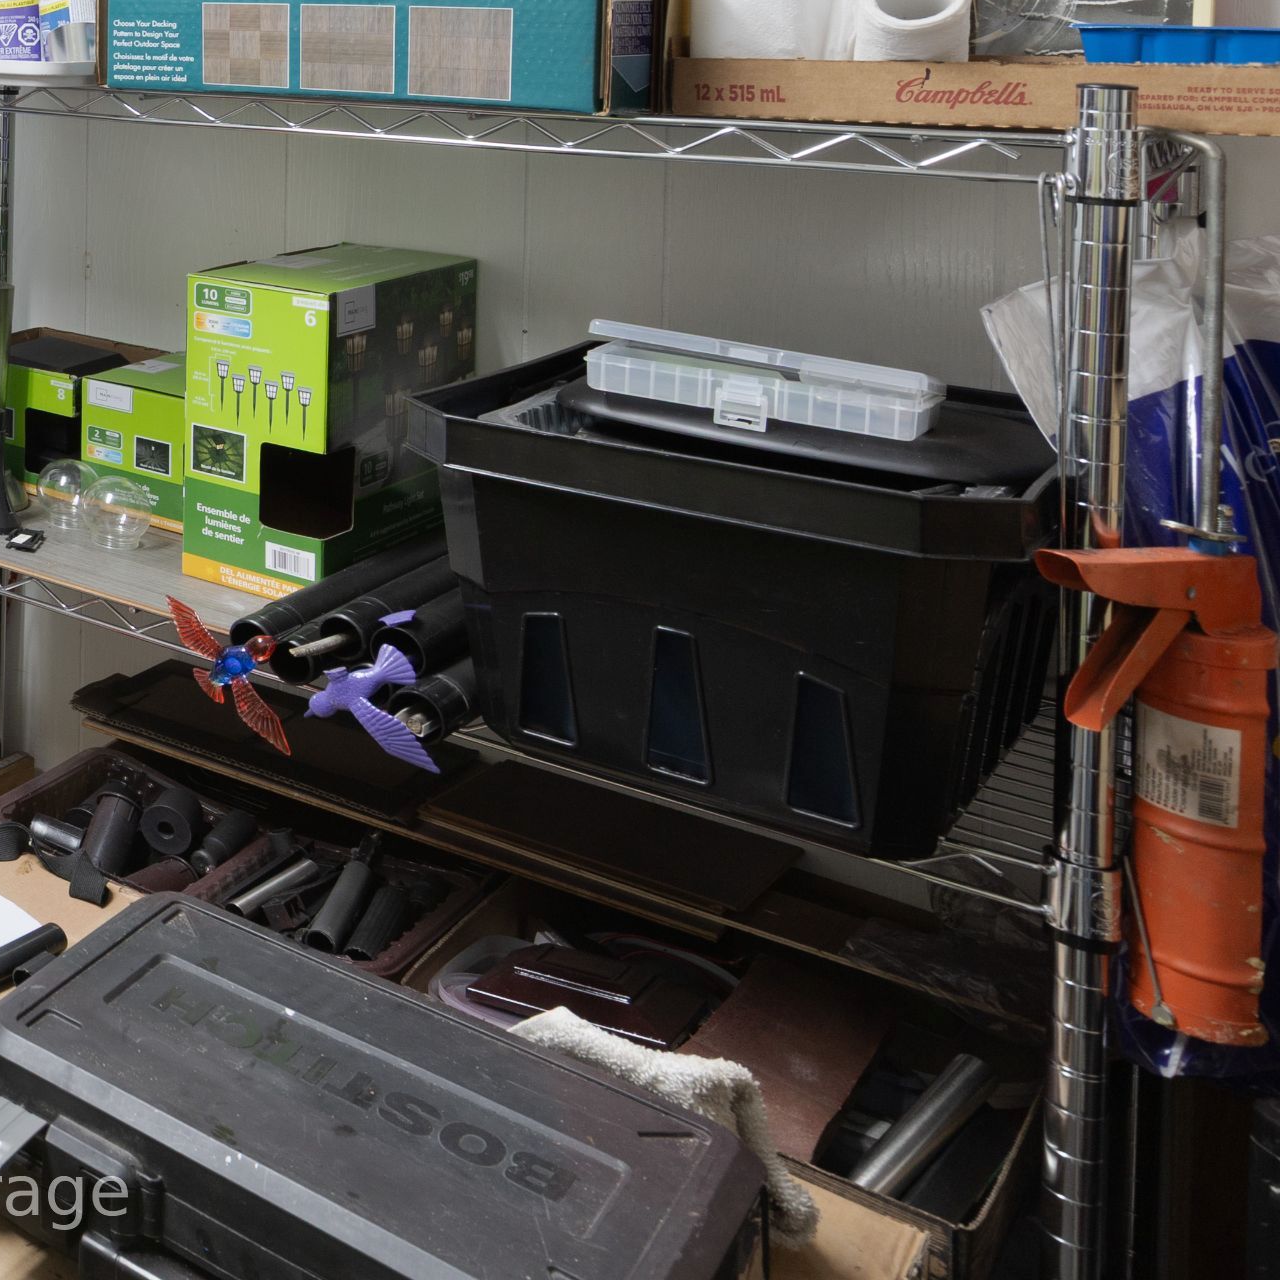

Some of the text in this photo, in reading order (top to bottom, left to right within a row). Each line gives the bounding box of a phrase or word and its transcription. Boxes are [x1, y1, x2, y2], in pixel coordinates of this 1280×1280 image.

[113, 19, 177, 29] Choose Your Decking
[142, 30, 163, 39] Design
[133, 40, 159, 48] Outdoor
[161, 41, 180, 49] Space
[113, 52, 145, 60] Choisissez
[152, 53, 168, 61] motif
[113, 62, 141, 72] platelage
[144, 73, 160, 82] plein
[694, 83, 786, 103] 12 x 515 mL
[895, 77, 1029, 110] Campbell's
[1187, 86, 1218, 94] READY
[1236, 87, 1266, 95] SERVE
[1201, 95, 1249, 104] CAMPBELL
[1252, 96, 1280, 104] COMP
[202, 288, 218, 301] 10
[304, 310, 317, 326] 6
[57, 388, 66, 401] 8
[196, 502, 251, 524] Ensemble de
[204, 516, 242, 533] lumières
[201, 526, 245, 545] de sentier
[219, 566, 236, 577] DEL
[236, 568, 281, 590] ALIMENTÉE
[150, 985, 580, 1204] BOSTITCH
